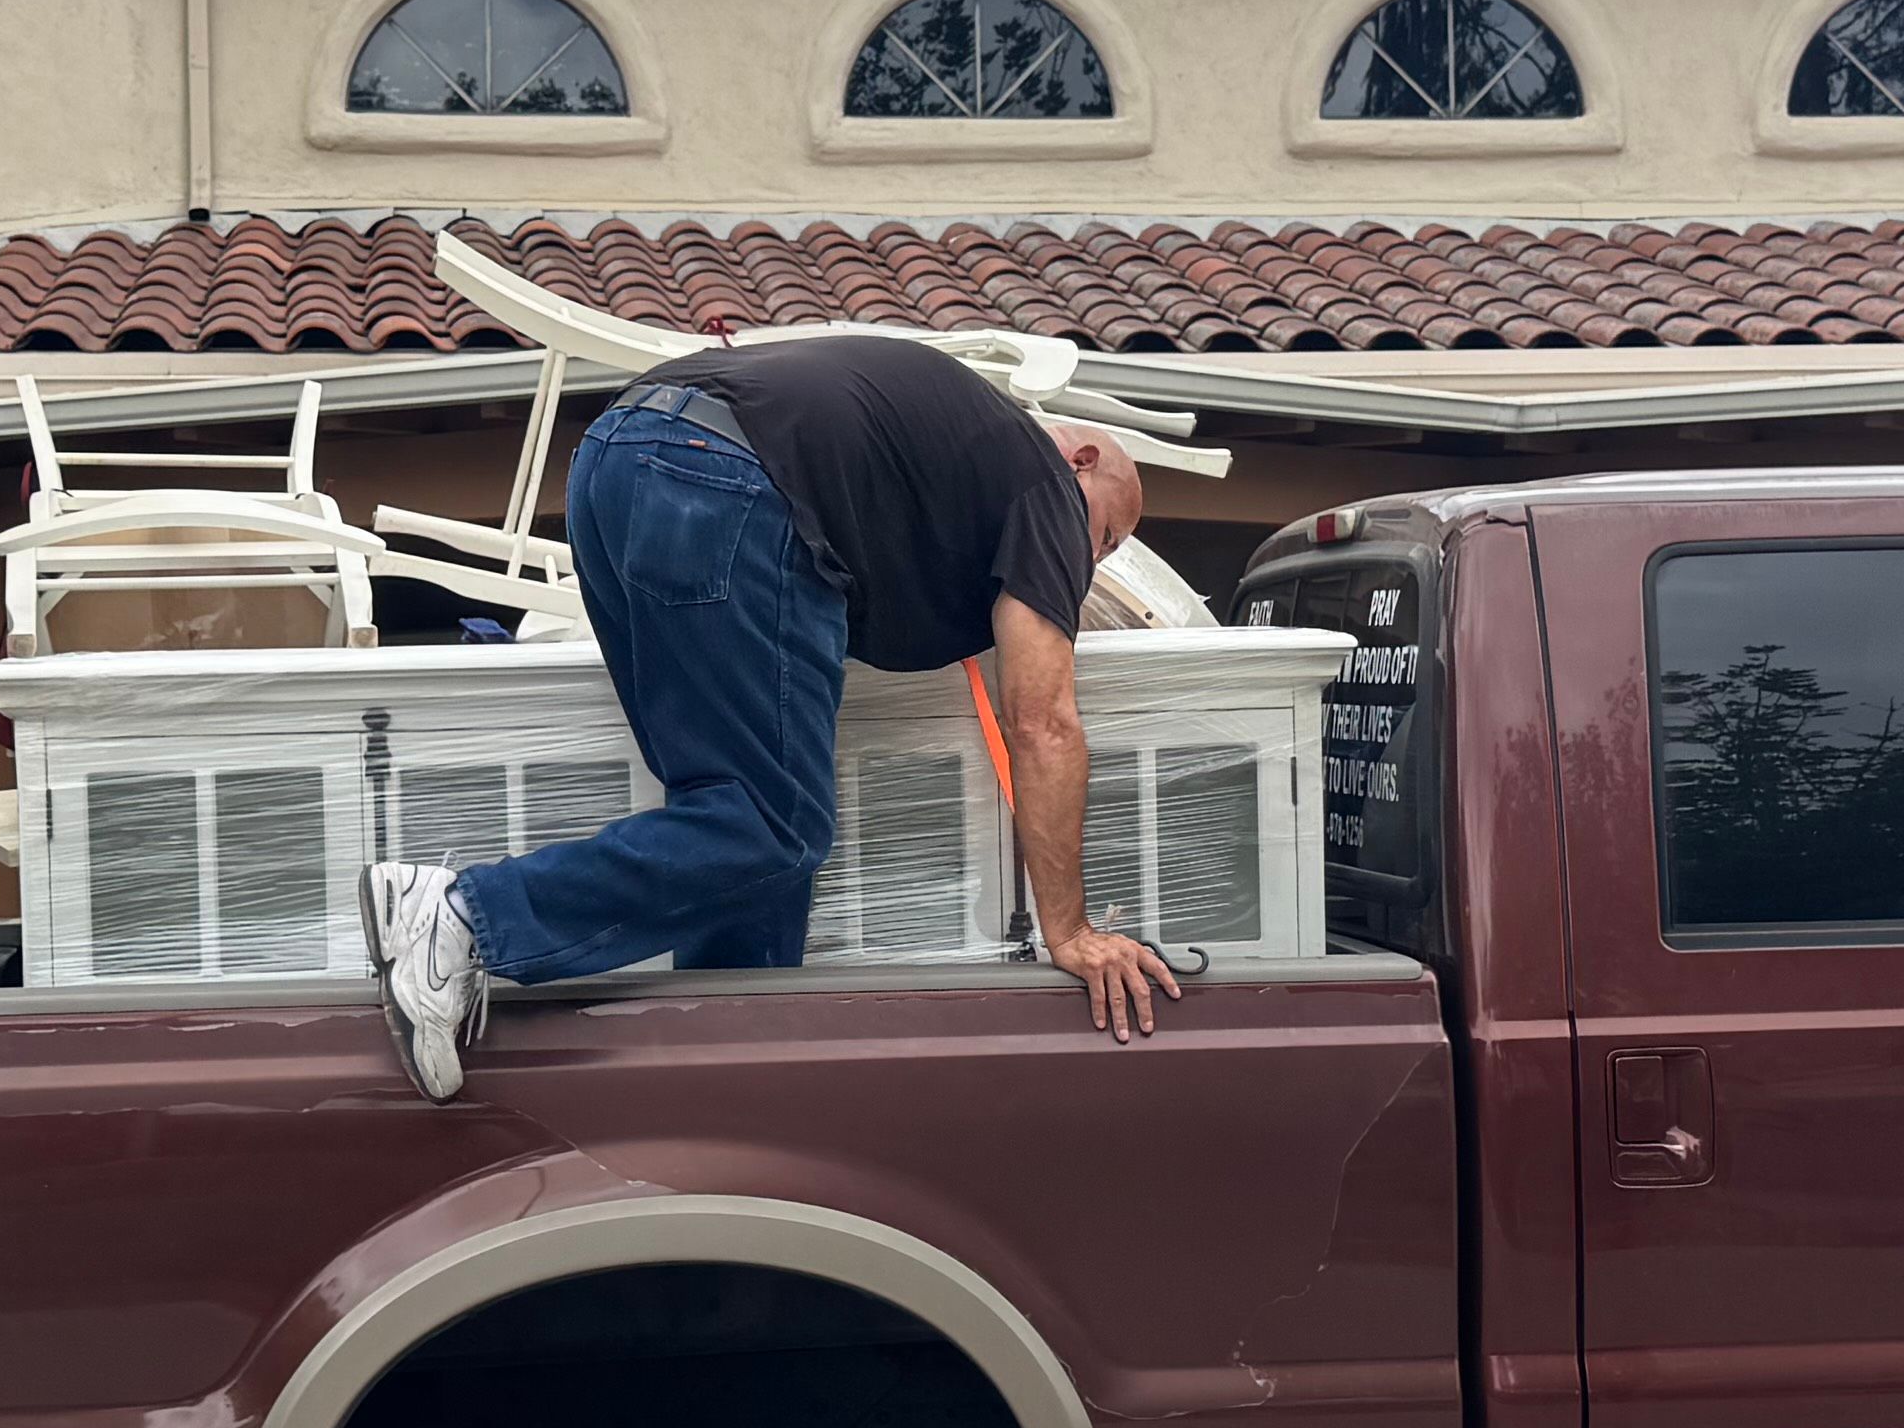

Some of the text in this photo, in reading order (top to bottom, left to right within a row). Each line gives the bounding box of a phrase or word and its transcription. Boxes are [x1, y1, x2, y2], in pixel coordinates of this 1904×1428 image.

[1368, 589, 1401, 627] PRAY
[1352, 646, 1392, 684] PROUD
[1390, 647, 1407, 685] OF
[1330, 704, 1361, 741] THEIR
[1362, 705, 1393, 743] LIVES
[1328, 757, 1341, 794] TO
[1343, 758, 1366, 797] LIVE
[1367, 763, 1400, 802] OURS.
